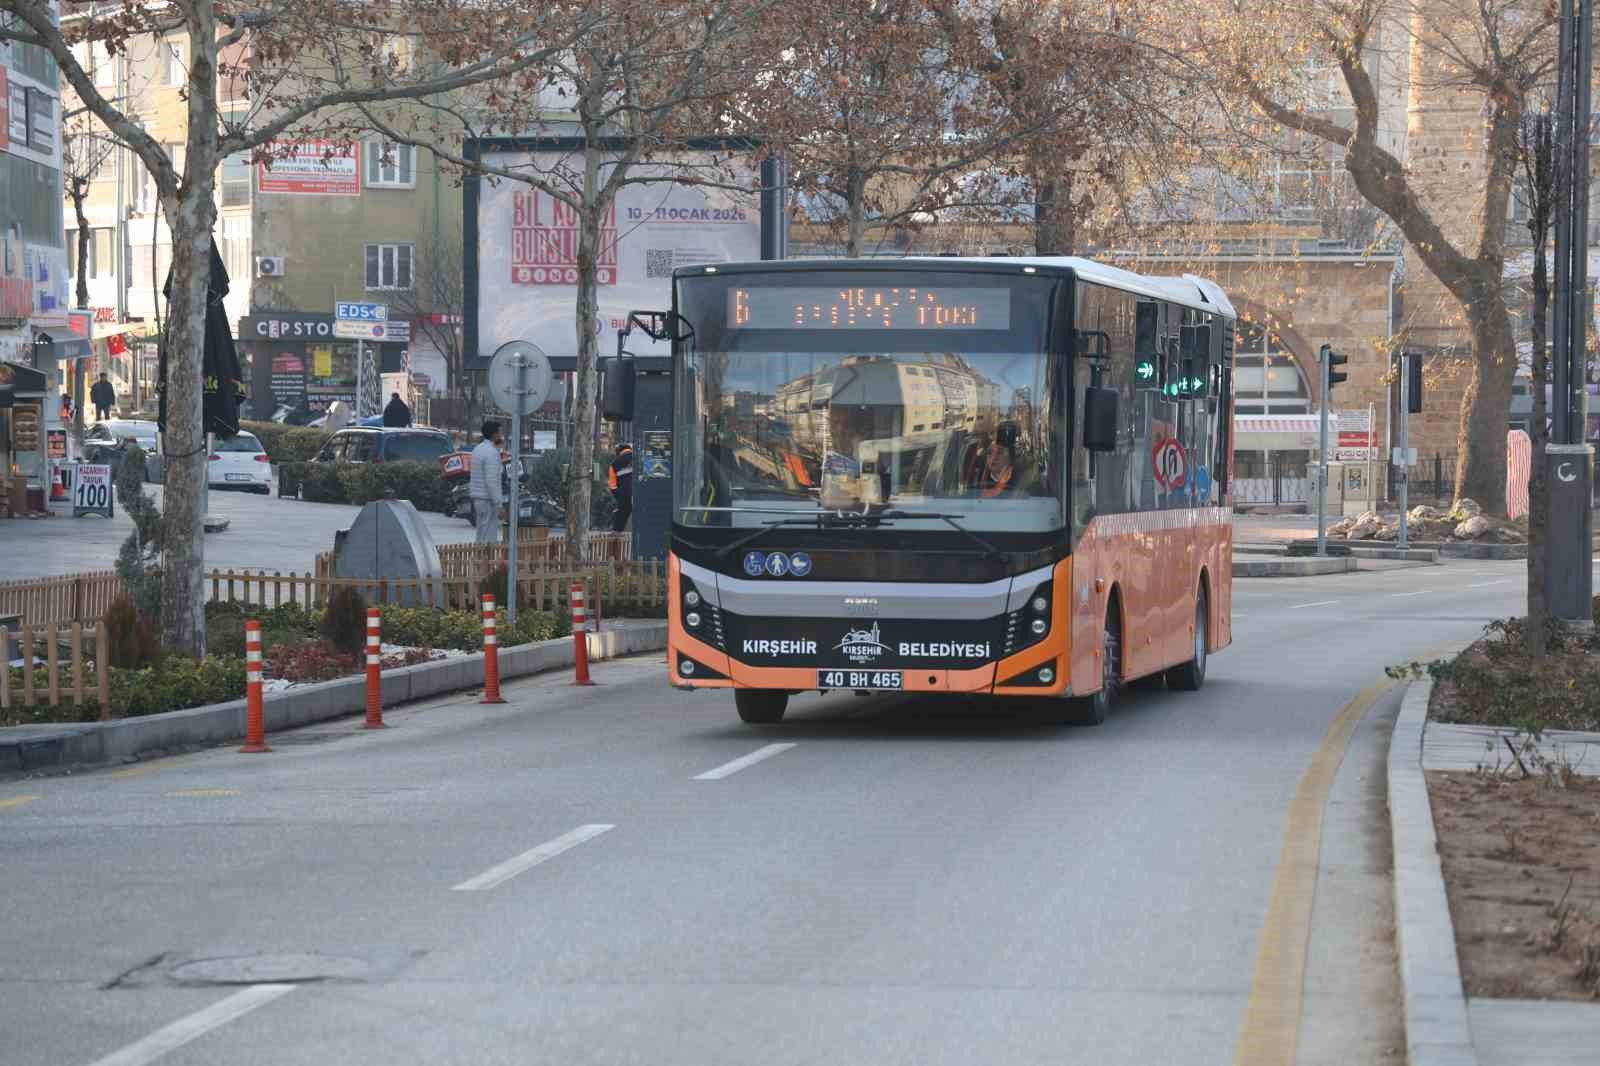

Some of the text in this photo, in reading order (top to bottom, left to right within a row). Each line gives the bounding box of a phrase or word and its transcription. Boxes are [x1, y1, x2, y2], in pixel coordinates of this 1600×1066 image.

[628, 208, 642, 219] 10
[668, 208, 710, 220] OCAK
[714, 208, 746, 220] 2026
[339, 304, 370, 317] EDS
[78, 484, 107, 506] 100
[743, 637, 990, 658] KIRŞEHİR BELEDİYESİ
[825, 671, 900, 687] 40 BH 465
